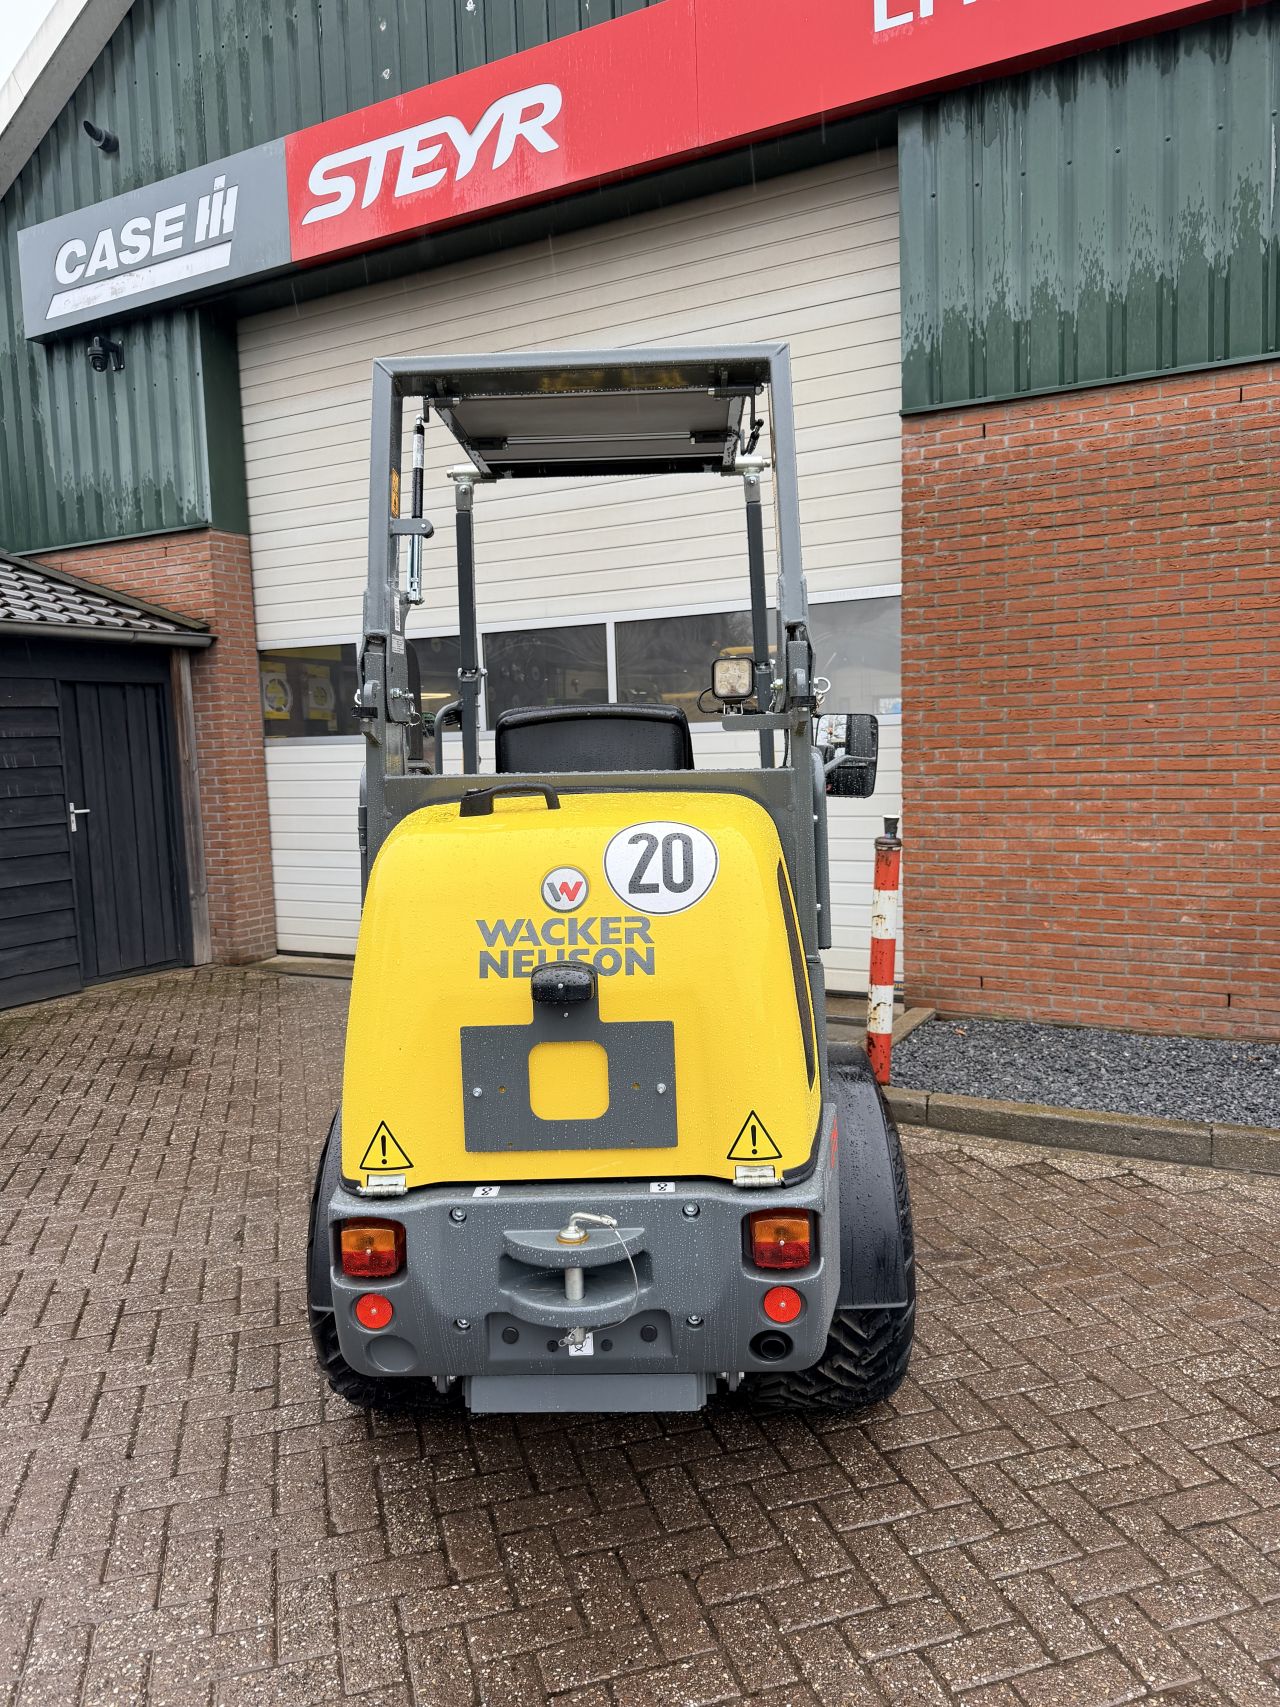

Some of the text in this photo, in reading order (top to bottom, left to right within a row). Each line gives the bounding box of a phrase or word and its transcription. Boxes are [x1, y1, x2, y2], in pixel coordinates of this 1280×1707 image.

[302, 83, 562, 225] STEYR
[54, 203, 186, 285] CASE
[628, 833, 694, 894] 20
[476, 916, 655, 947] WACKER
